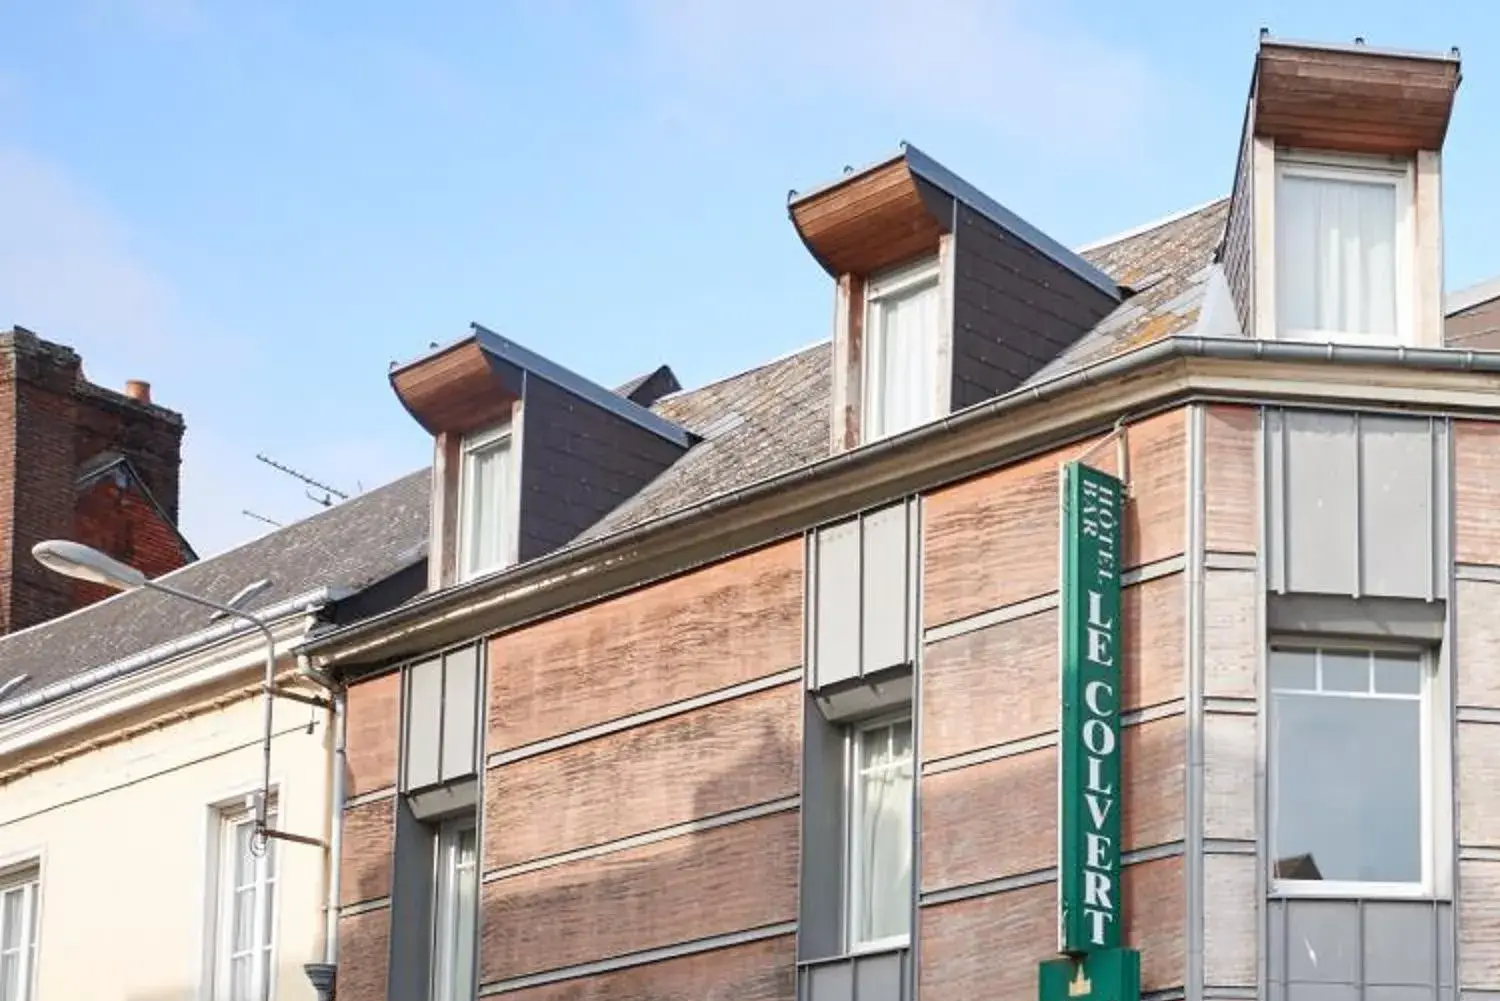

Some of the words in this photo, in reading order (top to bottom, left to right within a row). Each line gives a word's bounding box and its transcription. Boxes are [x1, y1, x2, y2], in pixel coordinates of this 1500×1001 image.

[1083, 479, 1098, 537] BAR
[1087, 589, 1113, 667] LE
[1082, 680, 1116, 945] COLVERT
